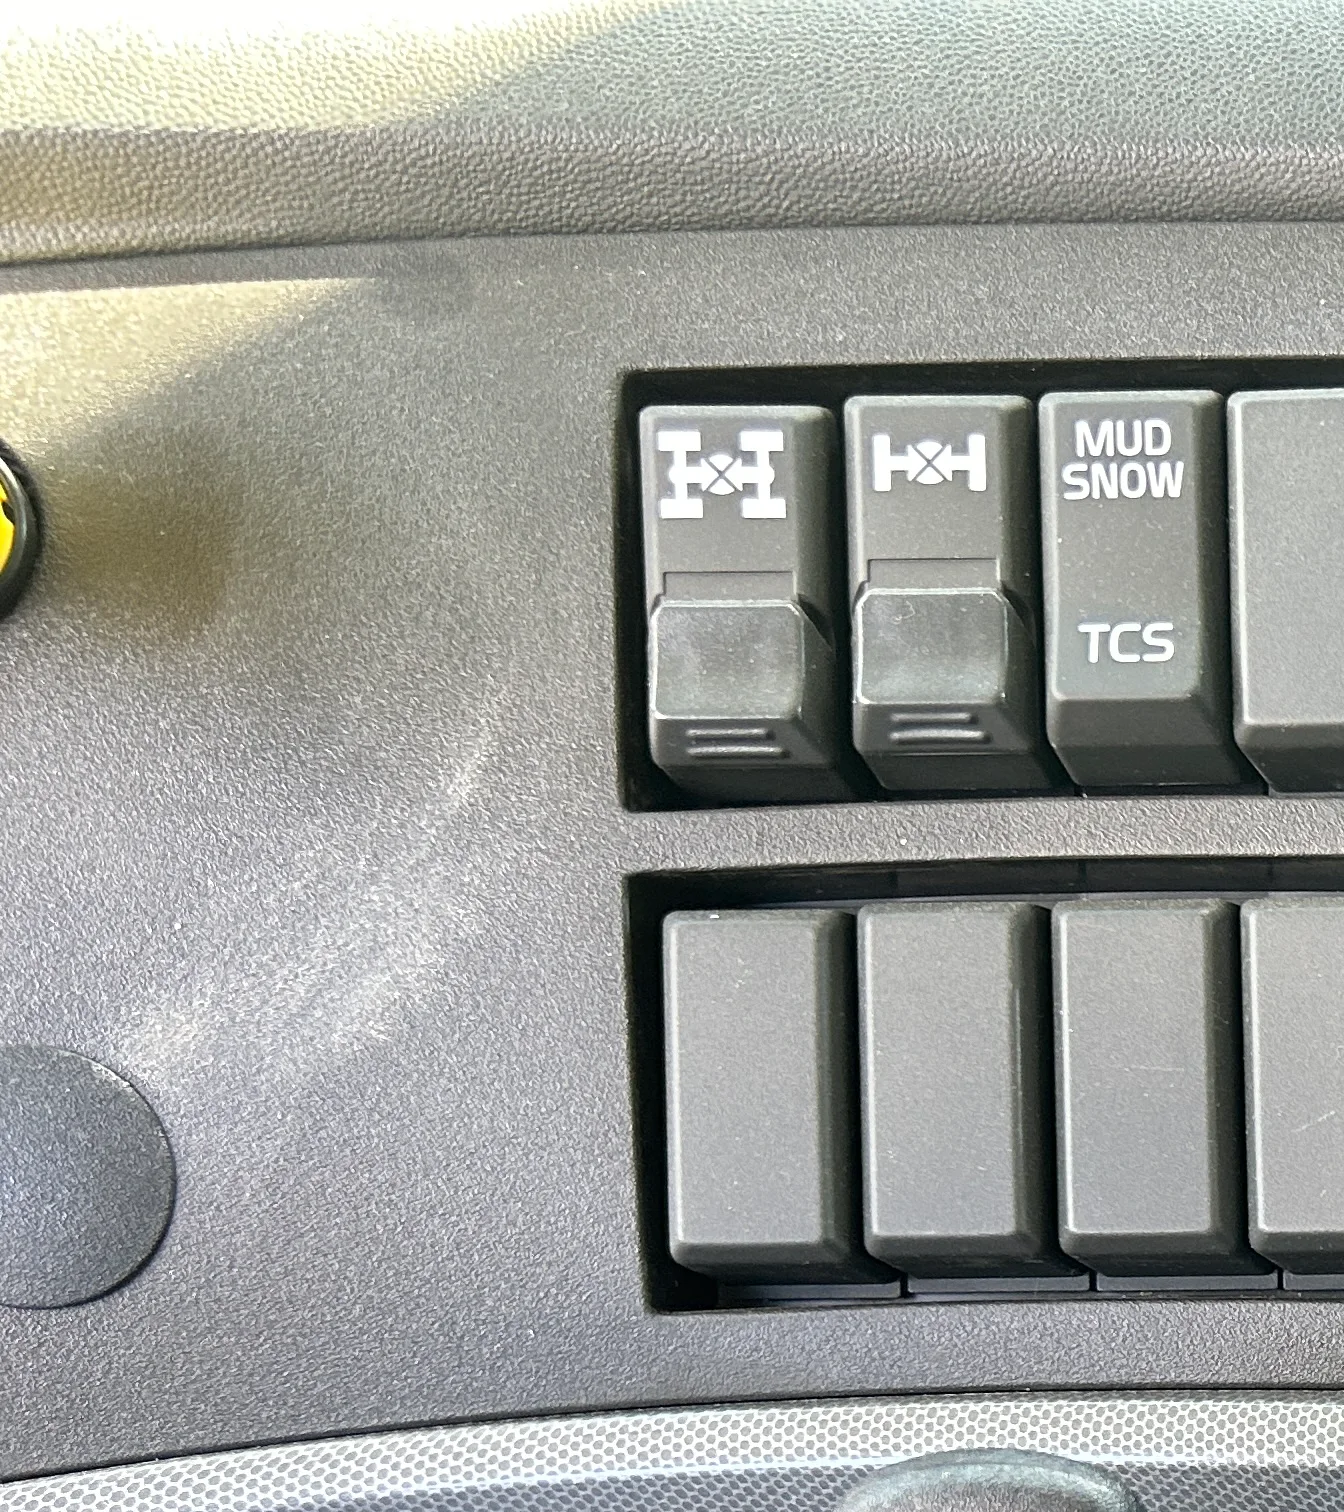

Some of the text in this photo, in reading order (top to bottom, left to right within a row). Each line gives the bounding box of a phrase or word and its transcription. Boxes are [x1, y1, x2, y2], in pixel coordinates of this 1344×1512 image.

[1075, 418, 1173, 458] MUD
[1062, 460, 1184, 500] SNOW
[1077, 622, 1175, 664] TCS
